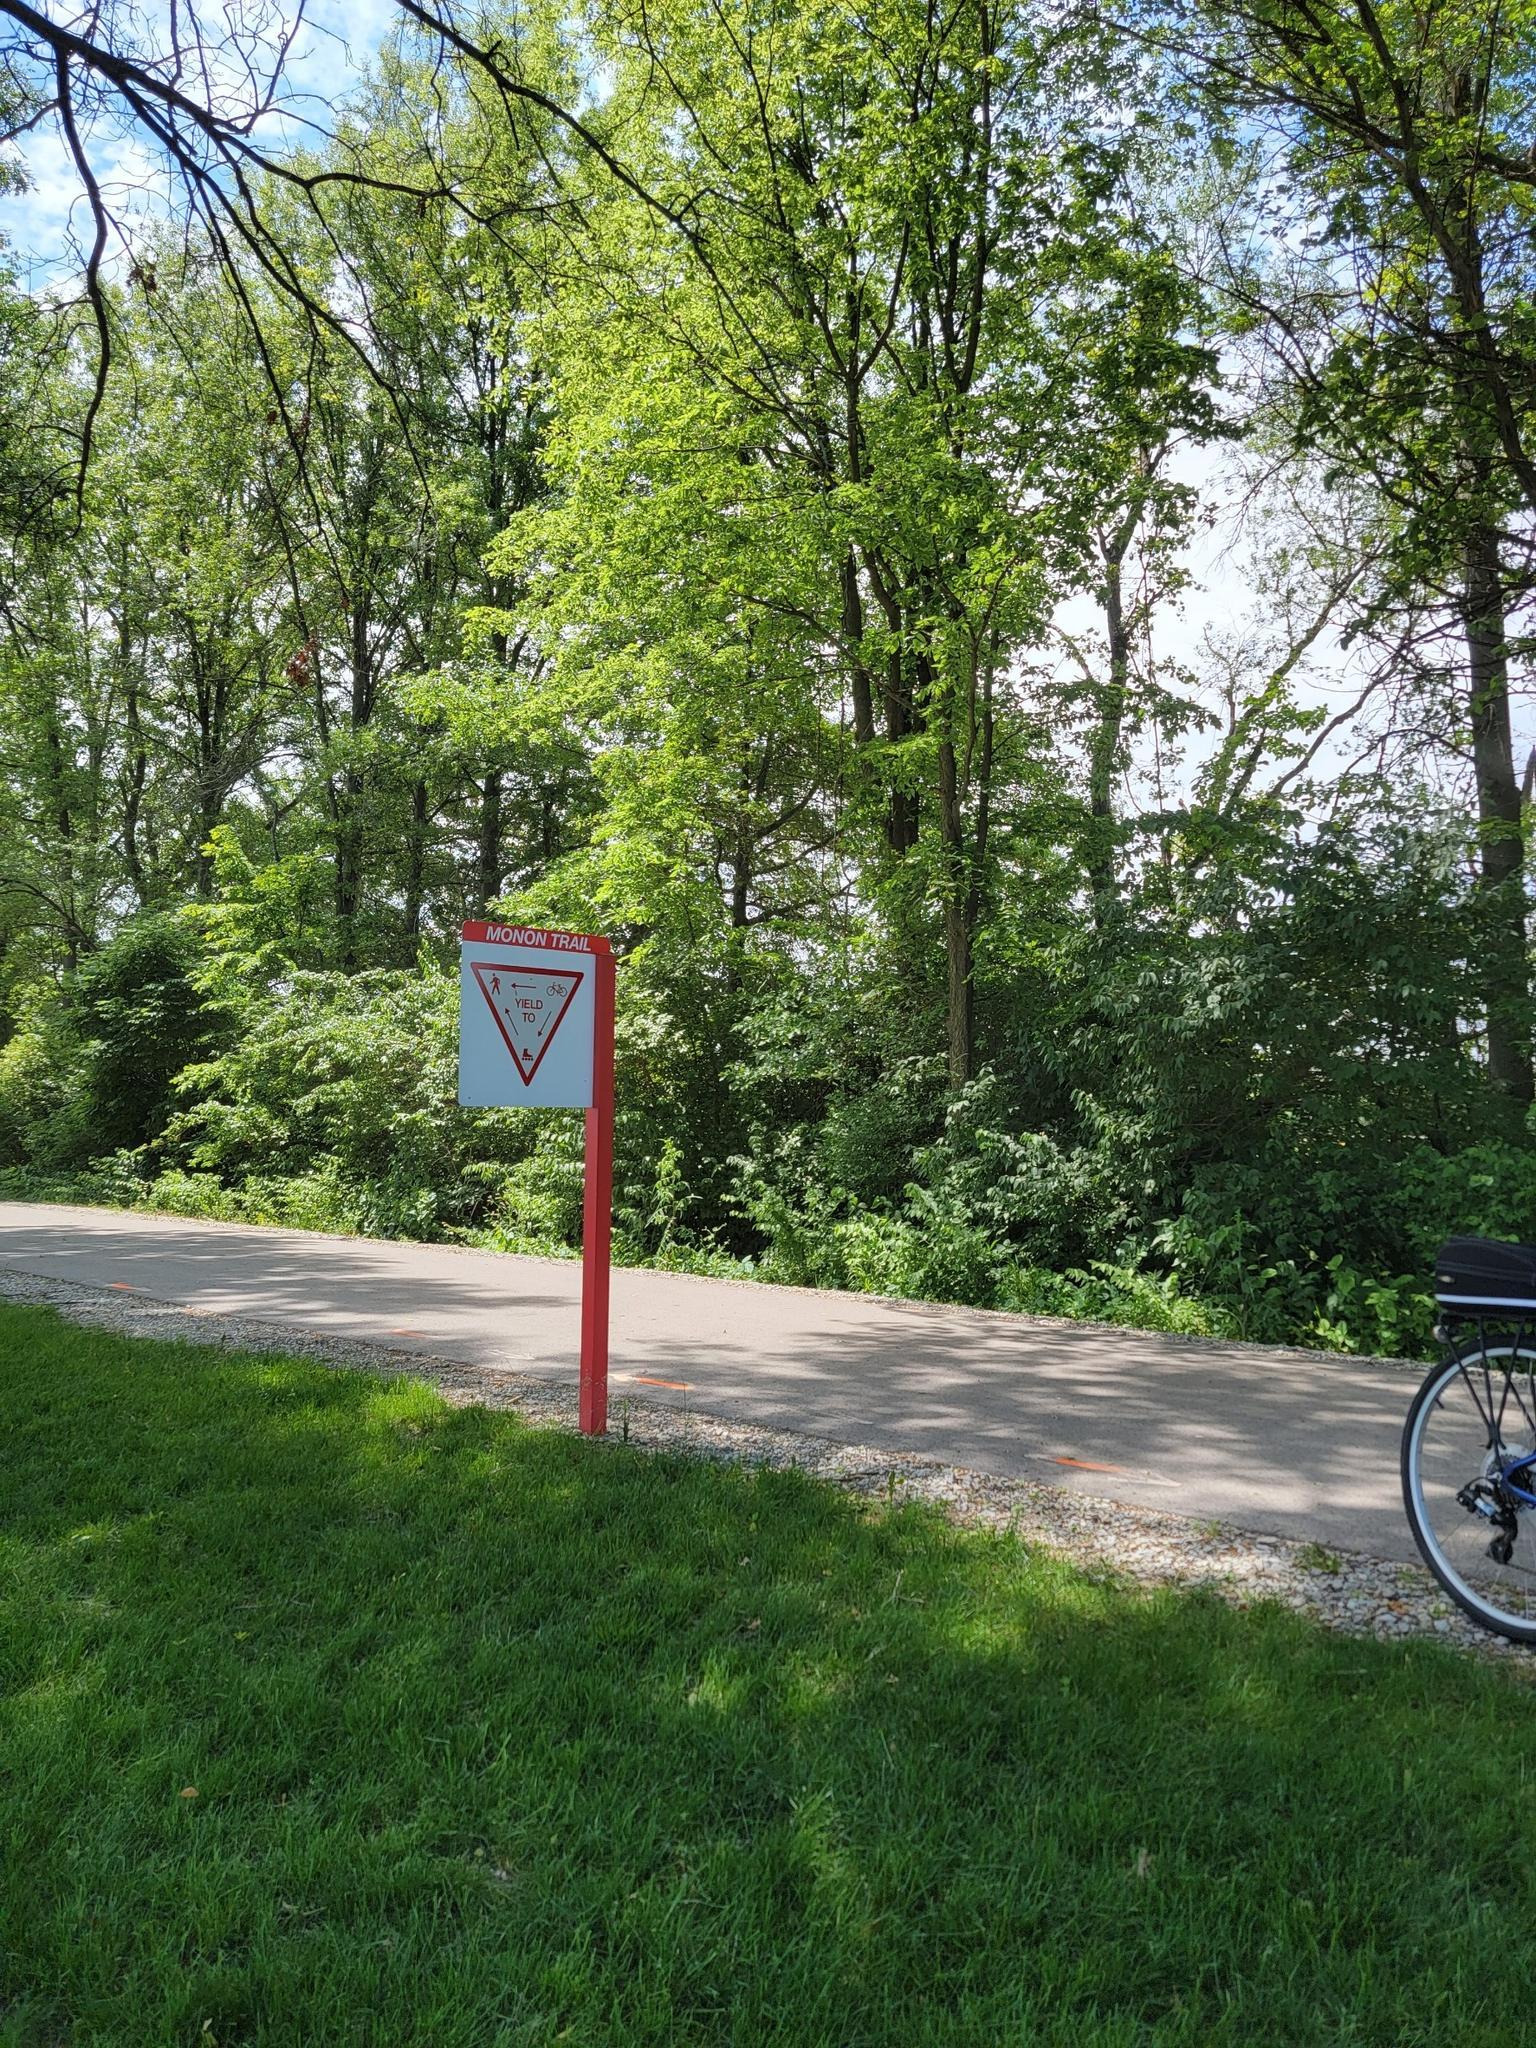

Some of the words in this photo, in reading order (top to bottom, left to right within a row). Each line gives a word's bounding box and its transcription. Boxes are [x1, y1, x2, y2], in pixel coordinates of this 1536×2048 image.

[486, 926, 547, 946] MONON
[551, 933, 591, 951] TRAIL
[515, 998, 543, 1009] YIELD
[522, 1012, 535, 1023] TO
